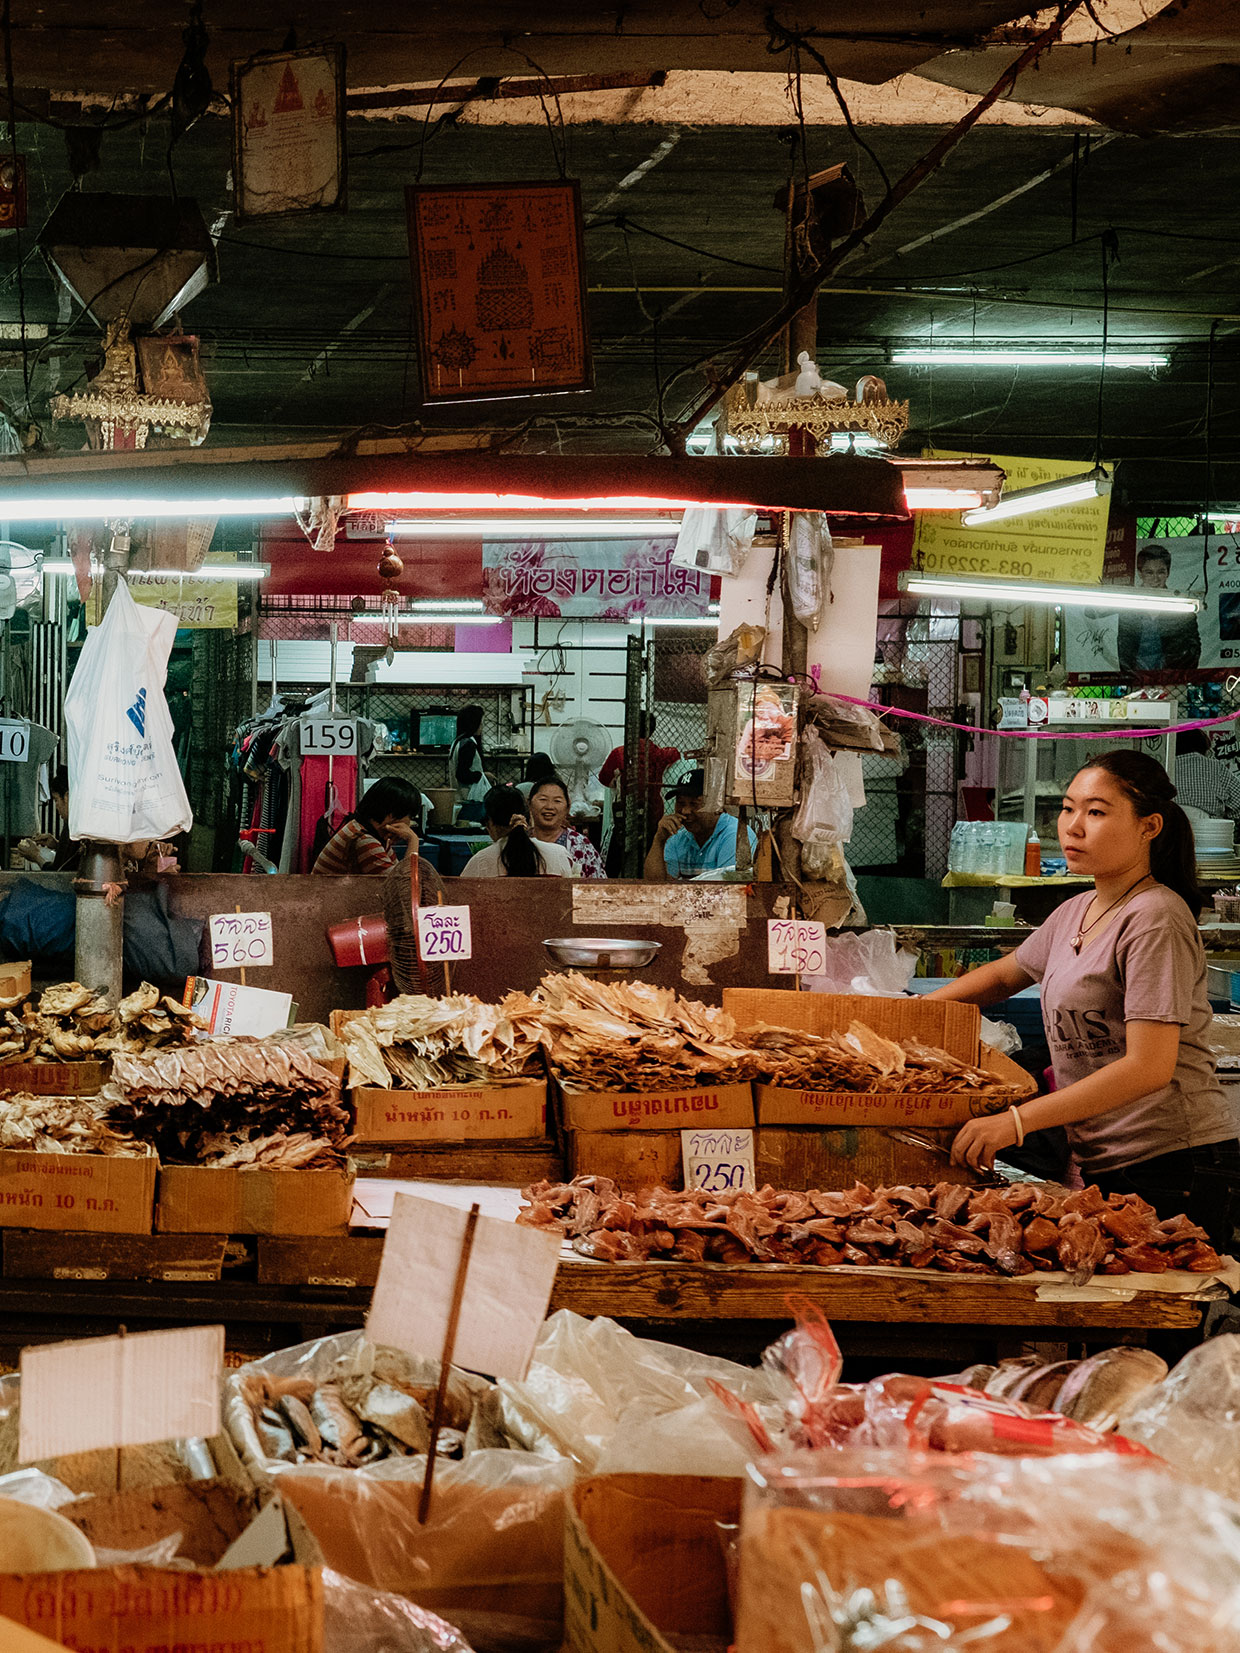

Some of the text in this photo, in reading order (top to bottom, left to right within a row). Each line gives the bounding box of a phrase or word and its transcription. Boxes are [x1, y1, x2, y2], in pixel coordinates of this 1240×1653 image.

[1217, 546, 1228, 566] 2
[500, 547, 702, 597] ห้องดอกไม
[303, 724, 355, 750] 159
[214, 917, 271, 937] โลละ
[425, 913, 460, 929] โลละ
[771, 922, 823, 943] โลละ
[213, 939, 267, 964] 560
[778, 948, 823, 972] 180
[226, 986, 238, 1017] TOYOTA
[385, 1104, 513, 1123] น้ำหนัก 10 ก.ก.
[55, 1193, 75, 1209] 10
[86, 1196, 120, 1213] ก.ก.
